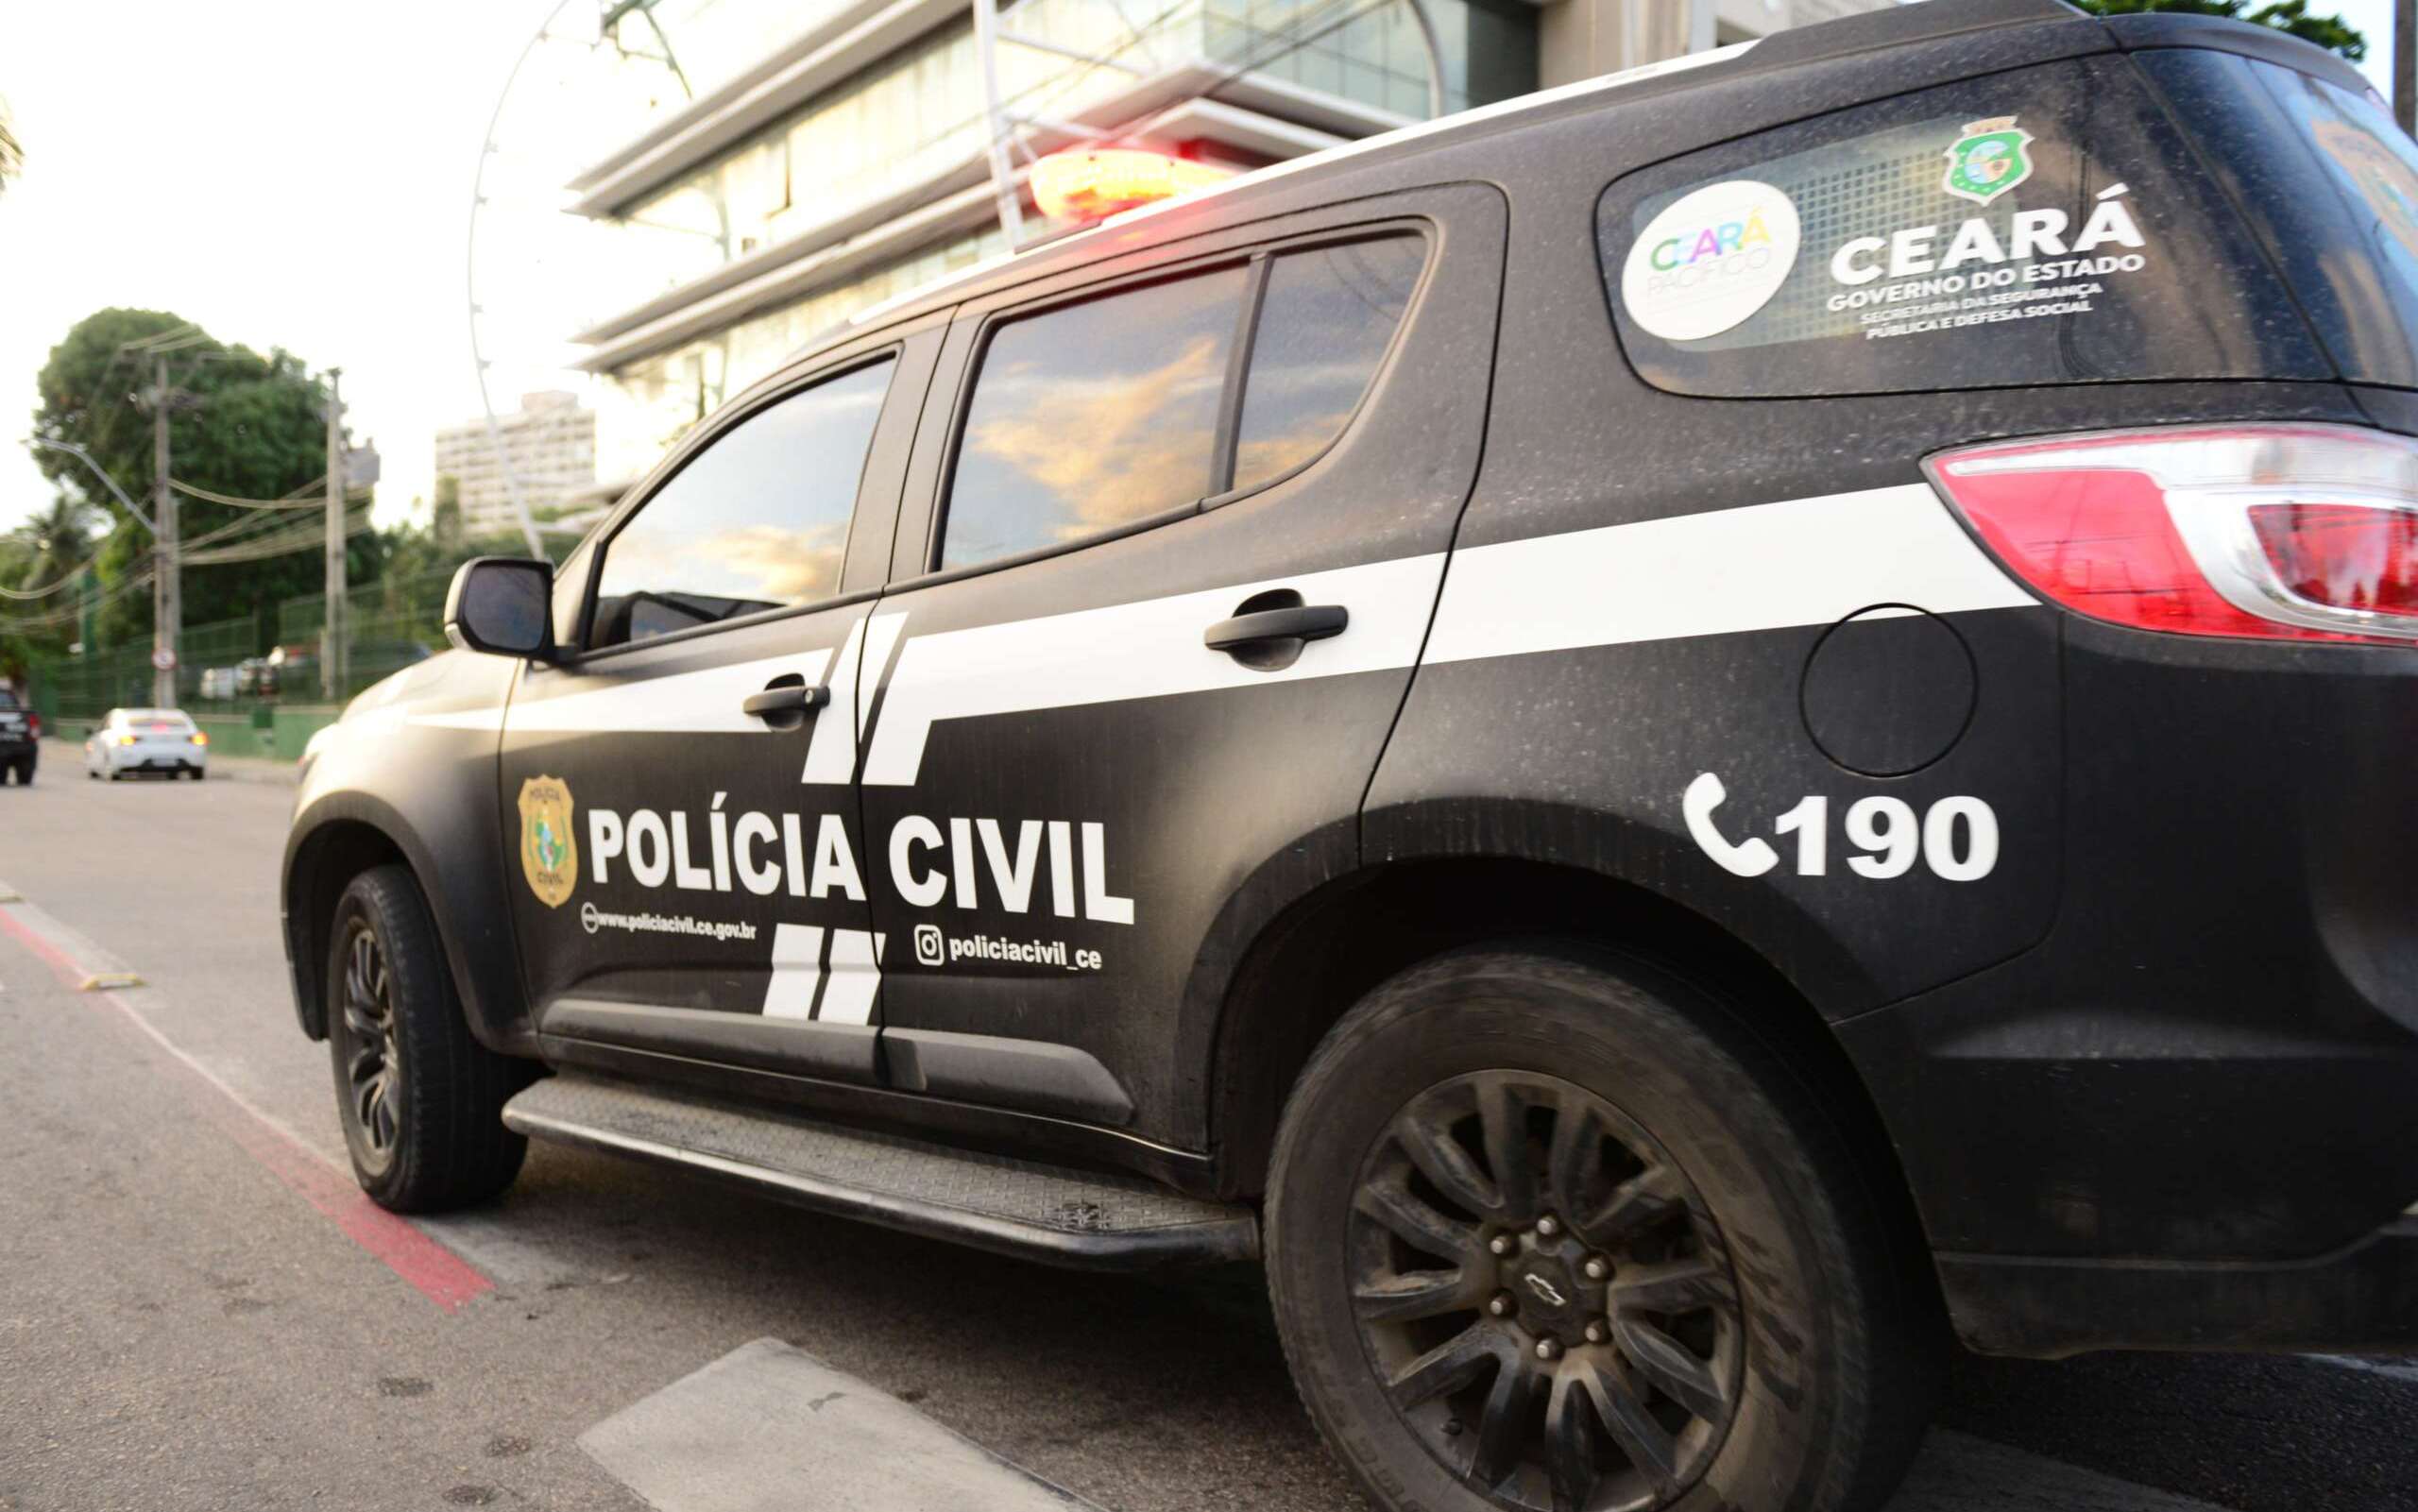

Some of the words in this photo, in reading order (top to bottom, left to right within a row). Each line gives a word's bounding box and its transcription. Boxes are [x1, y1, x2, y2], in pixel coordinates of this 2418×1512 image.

[1831, 182, 2146, 285] CEARÁ
[1827, 278, 1965, 312] GOVERNO
[1970, 268, 2017, 290] DO
[2023, 253, 2146, 283] ESTADO
[1861, 300, 1959, 324] SECRETARIA
[1960, 296, 1988, 310] DA
[1988, 282, 2103, 307] SEGURANÇA
[1939, 317, 1952, 330] E
[1953, 308, 2023, 326] DEFESA
[2023, 300, 2093, 318] SOCIAL
[588, 791, 866, 901] POLÍCIA
[889, 815, 1133, 925] CIVIL
[1776, 795, 1999, 881] 190
[597, 912, 757, 941] www.policiacivil.ce.gov.br
[949, 935, 1102, 970] policiacivil_ce
